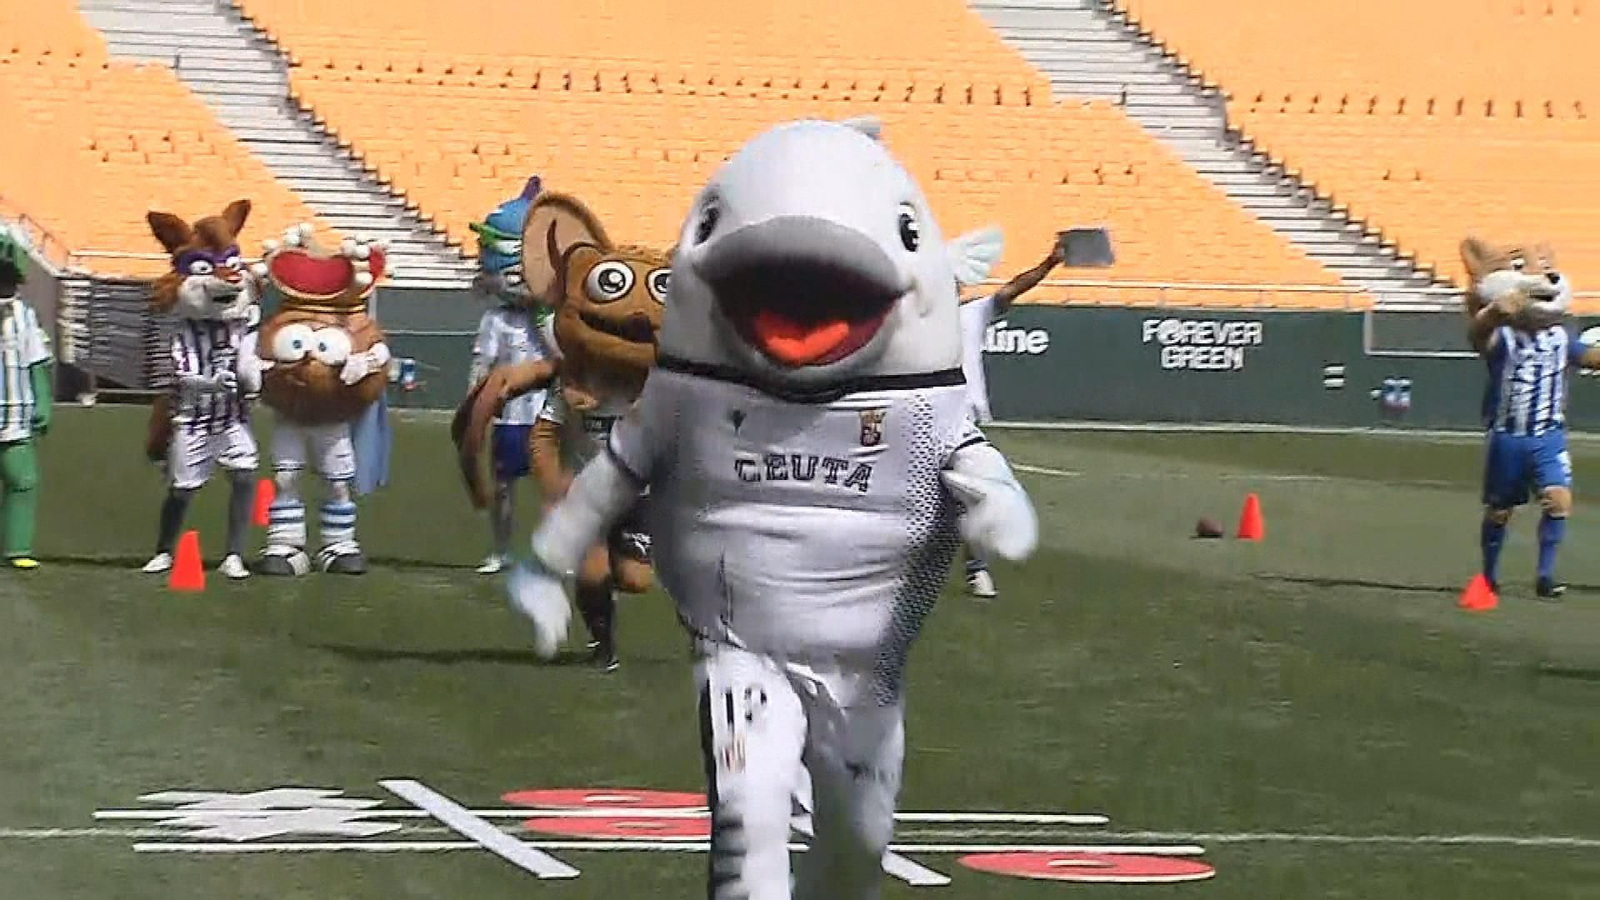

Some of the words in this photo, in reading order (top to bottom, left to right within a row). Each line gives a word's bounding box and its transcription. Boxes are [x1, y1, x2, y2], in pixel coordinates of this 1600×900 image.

[1142, 318, 1263, 345] FOREVER
[1160, 344, 1245, 371] GREEN
[734, 454, 873, 492] CEUTA
